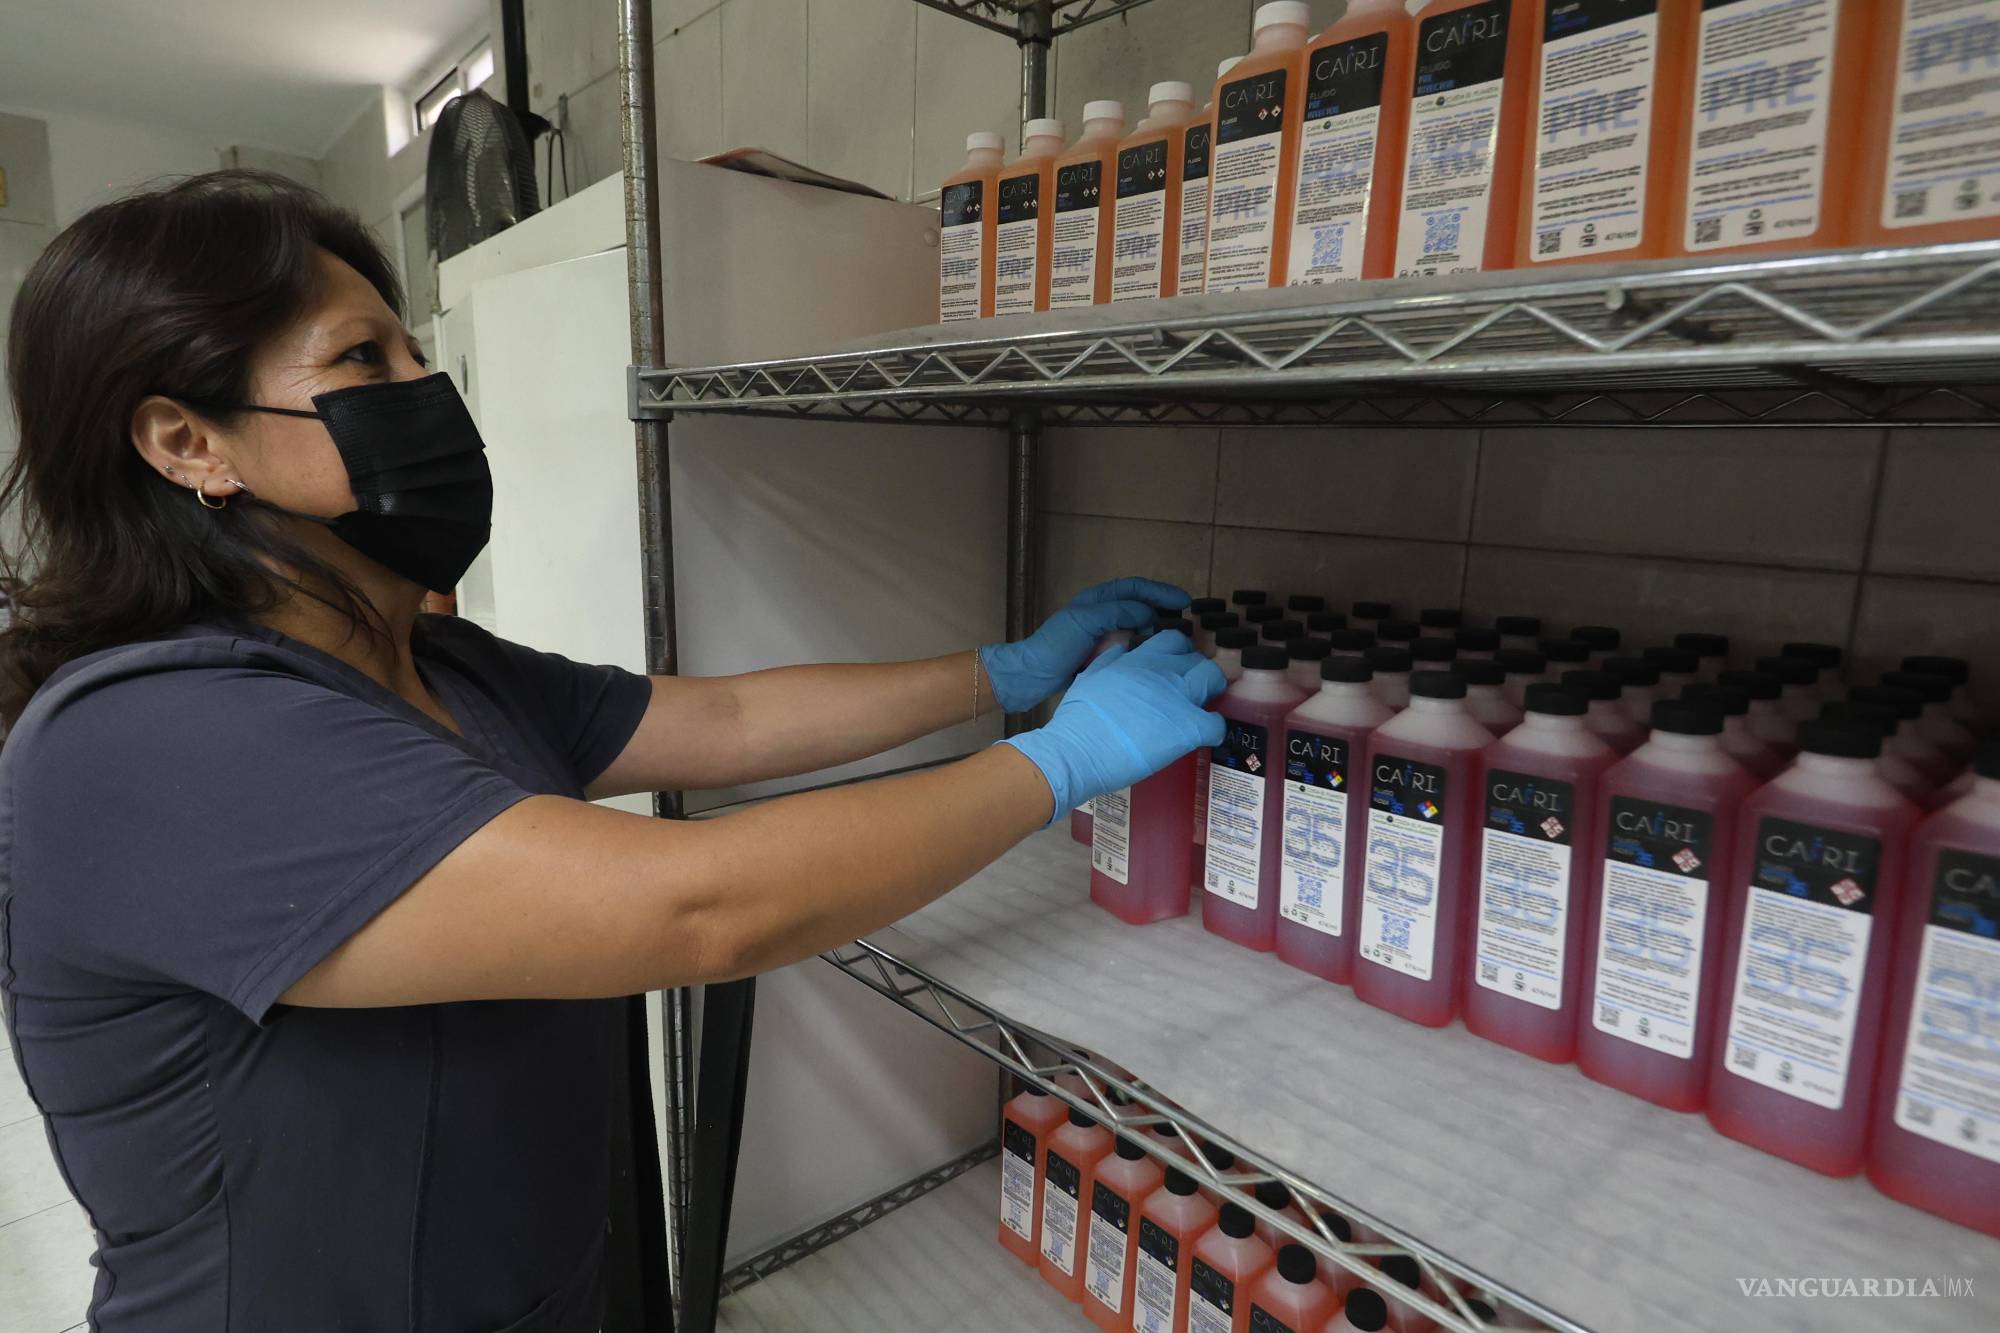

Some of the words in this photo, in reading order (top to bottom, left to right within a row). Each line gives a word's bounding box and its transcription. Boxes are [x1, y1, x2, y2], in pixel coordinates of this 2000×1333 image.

[1285, 806, 1342, 868] 35
[1368, 838, 1435, 906] 35
[1485, 858, 1560, 926] 35
[1606, 895, 1693, 967] 35
[1747, 927, 1851, 1009] 35
